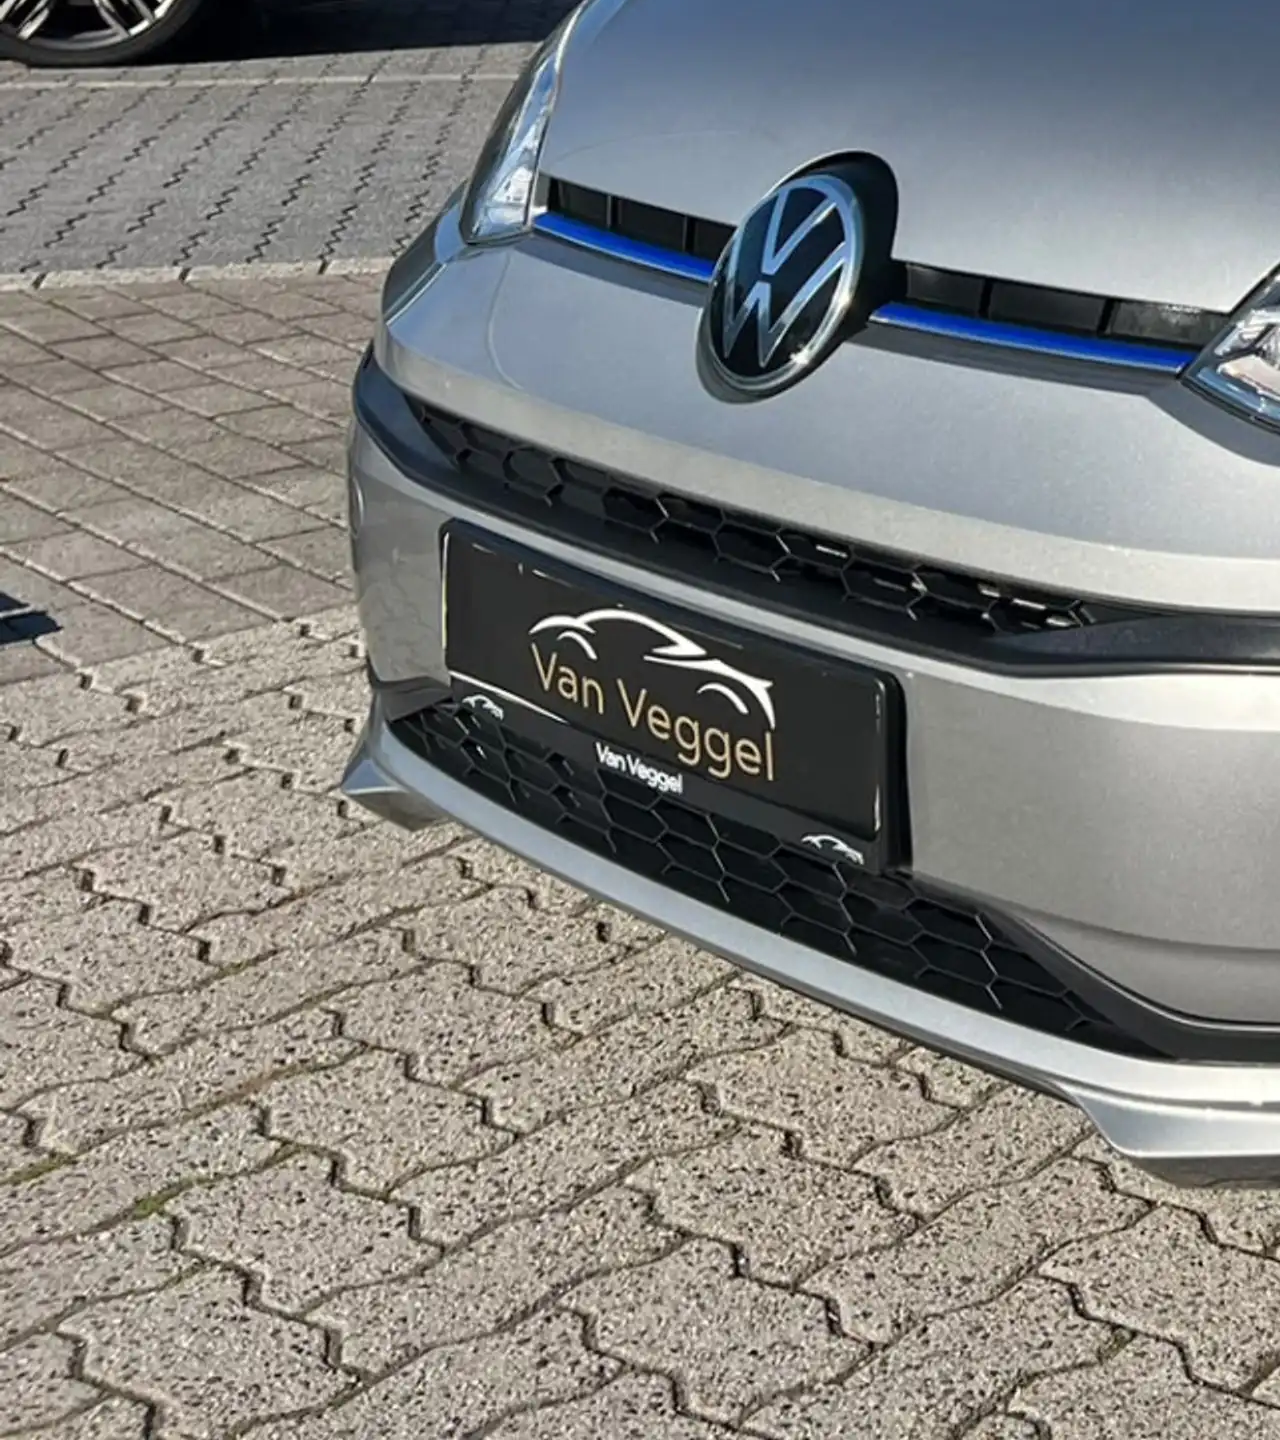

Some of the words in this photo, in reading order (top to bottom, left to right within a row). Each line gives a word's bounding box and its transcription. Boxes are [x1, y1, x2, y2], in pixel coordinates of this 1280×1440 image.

[531, 642, 604, 715] Van
[616, 677, 774, 782] Veggel
[596, 742, 626, 772] Van
[626, 754, 683, 794] Veggel
